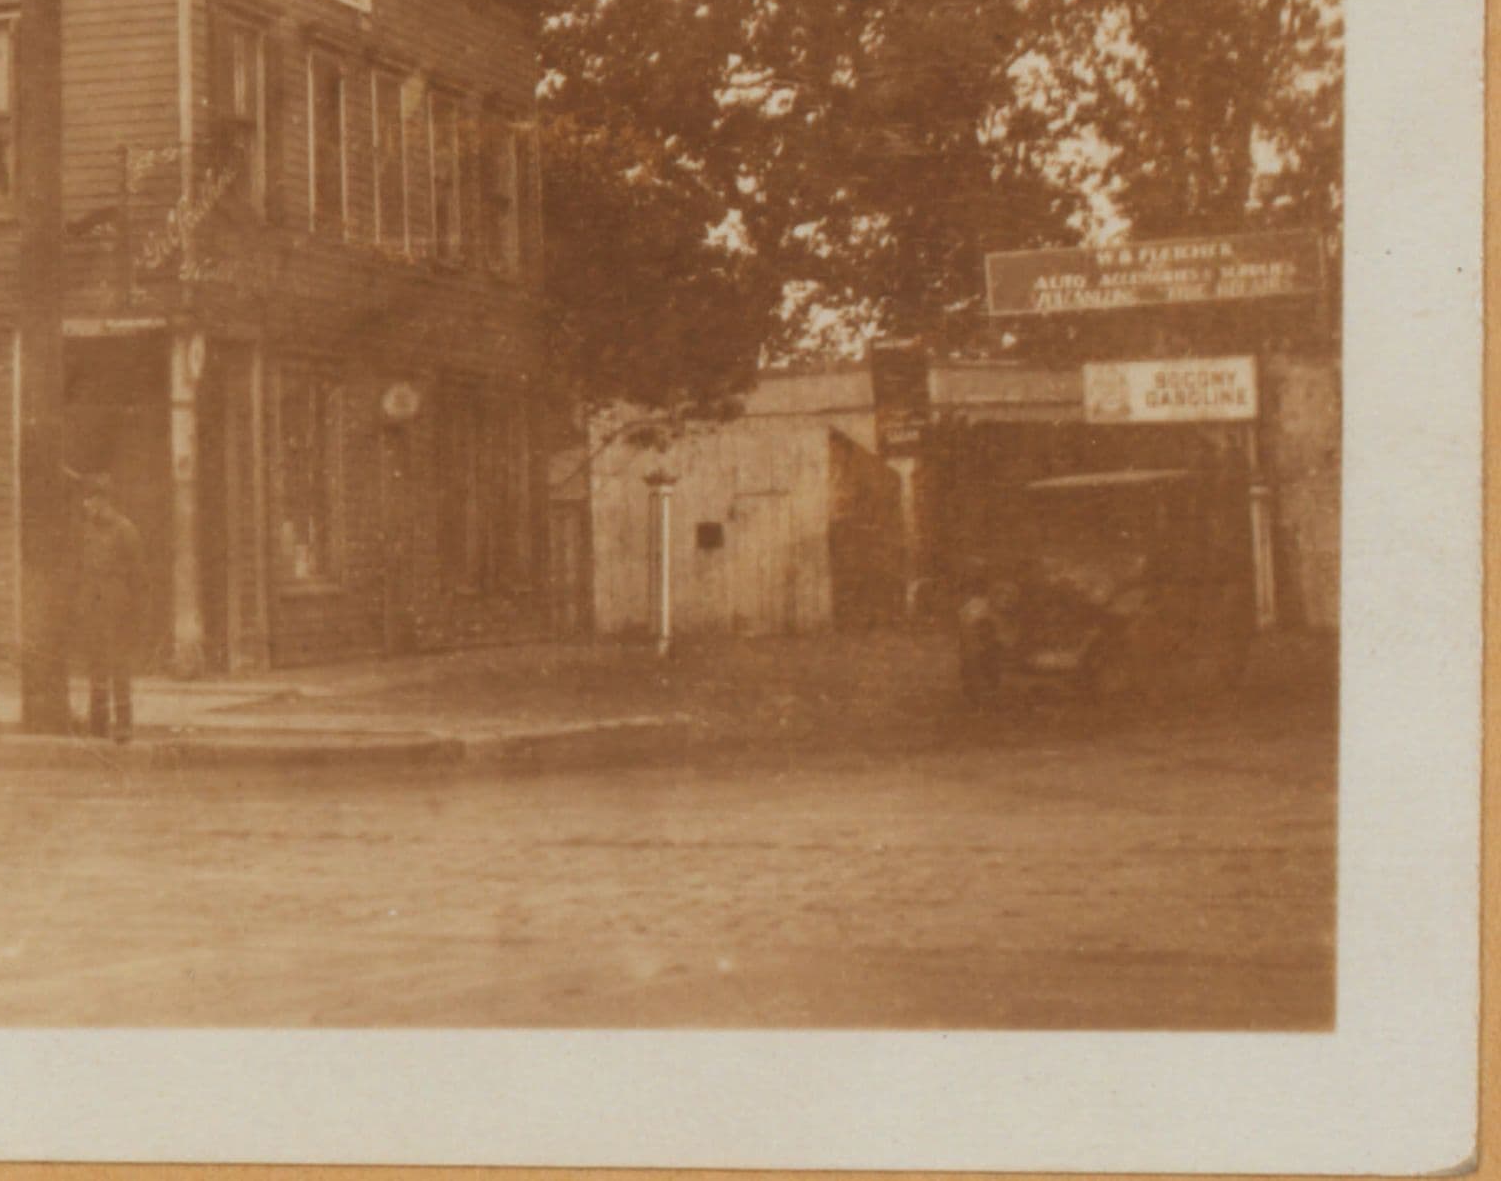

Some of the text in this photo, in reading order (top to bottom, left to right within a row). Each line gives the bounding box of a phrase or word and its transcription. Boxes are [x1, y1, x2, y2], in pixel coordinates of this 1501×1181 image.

[1033, 274, 1087, 291] AUTO
[1154, 369, 1238, 389] SOCONY
[1145, 386, 1247, 408] GASOLINE
